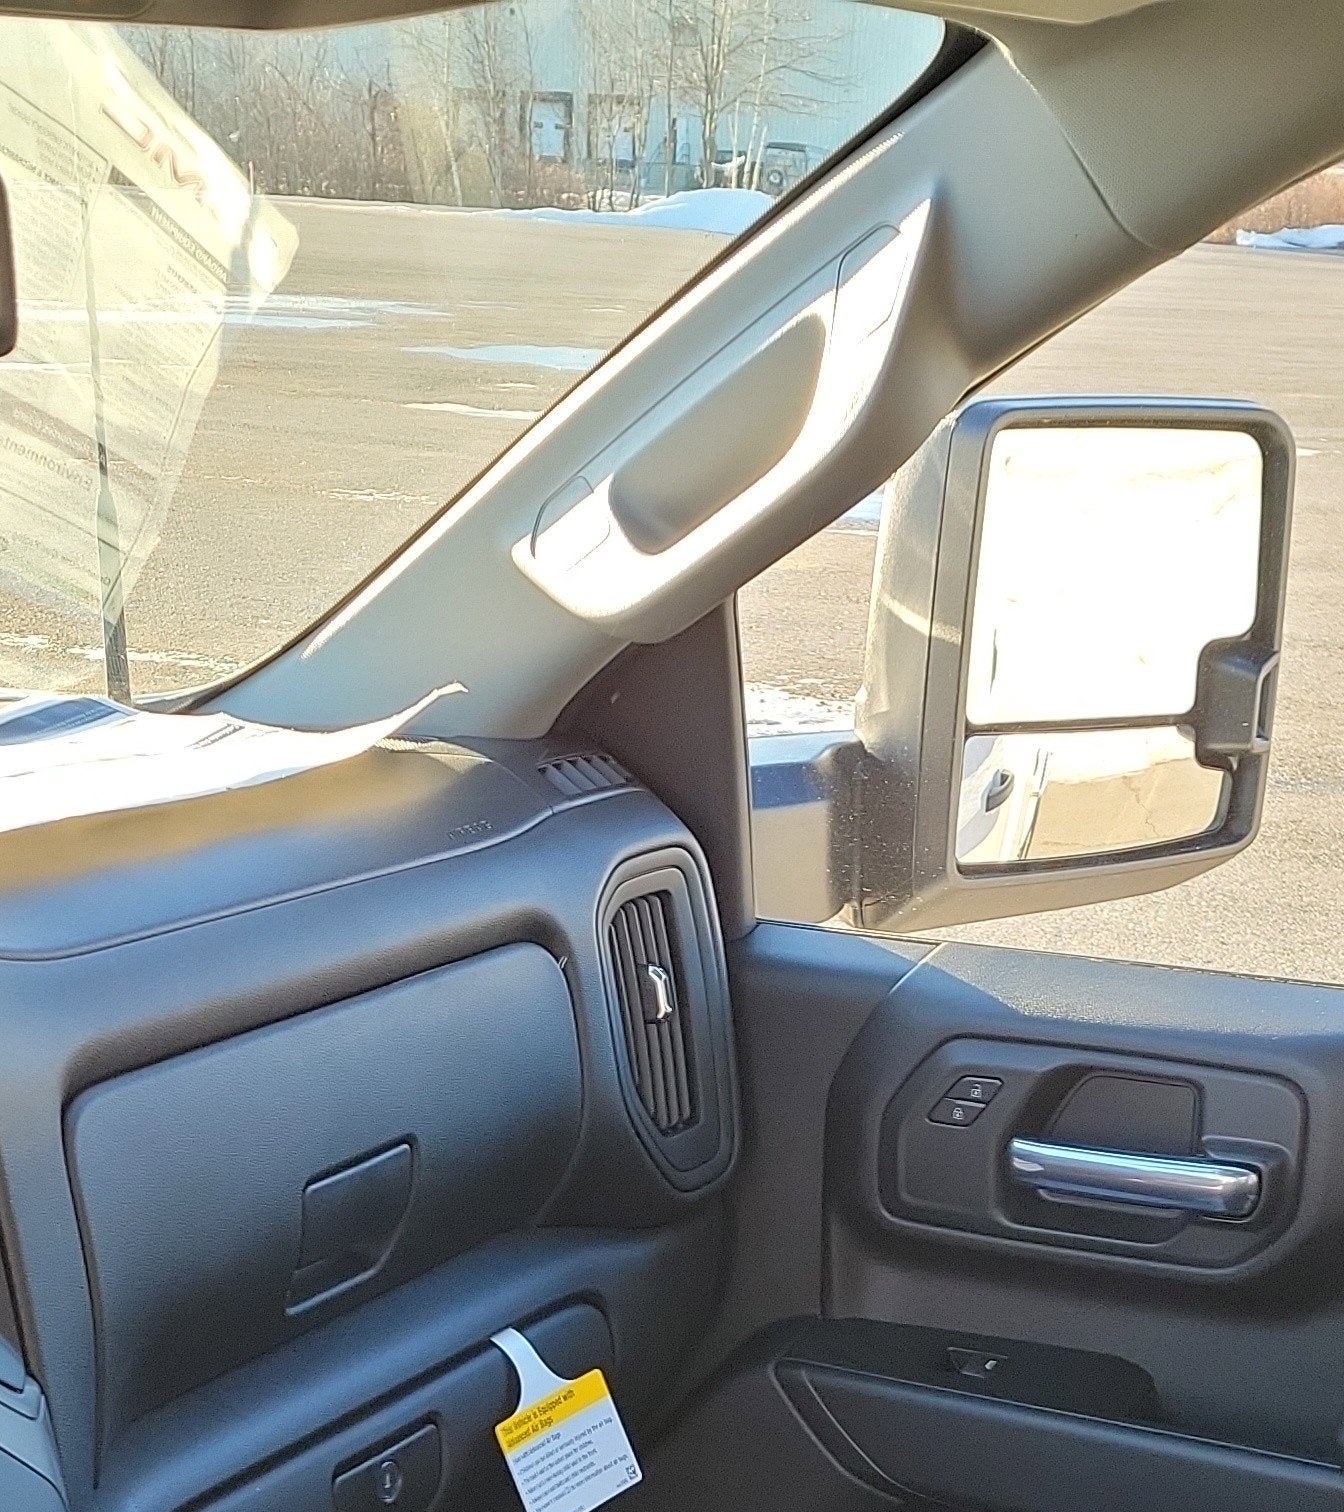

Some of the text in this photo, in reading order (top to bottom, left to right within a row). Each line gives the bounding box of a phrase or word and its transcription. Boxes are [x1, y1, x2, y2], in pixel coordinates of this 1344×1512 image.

[536, 1395, 564, 1418] Equipped
[560, 1387, 575, 1402] with
[538, 1414, 554, 1430] Bags
